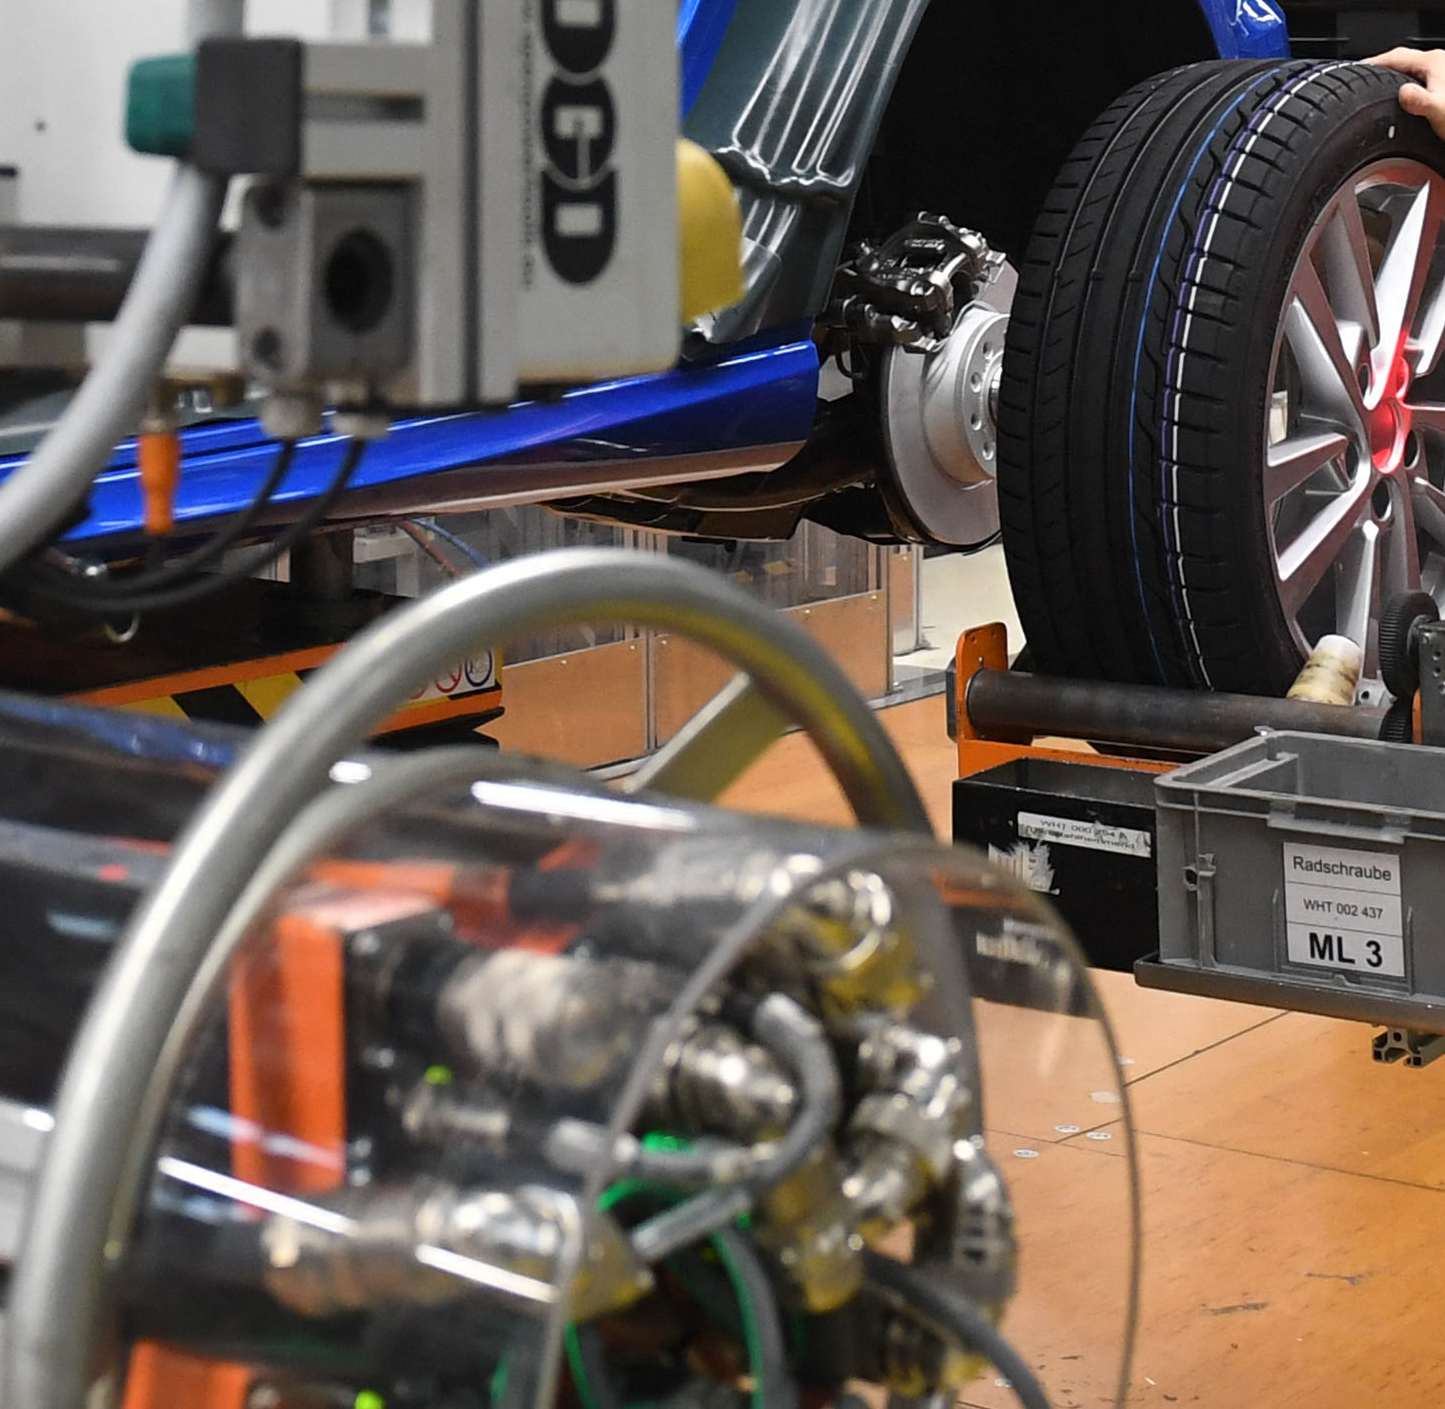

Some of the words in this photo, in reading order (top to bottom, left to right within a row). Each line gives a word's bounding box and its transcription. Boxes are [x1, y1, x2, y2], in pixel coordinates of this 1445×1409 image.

[1293, 855, 1392, 882] Radschraube
[1303, 898, 1333, 913] WHT
[1336, 902, 1359, 917] 002
[1361, 906, 1384, 920] 437
[1309, 932, 1356, 965] ML
[1365, 940, 1383, 968] 3
